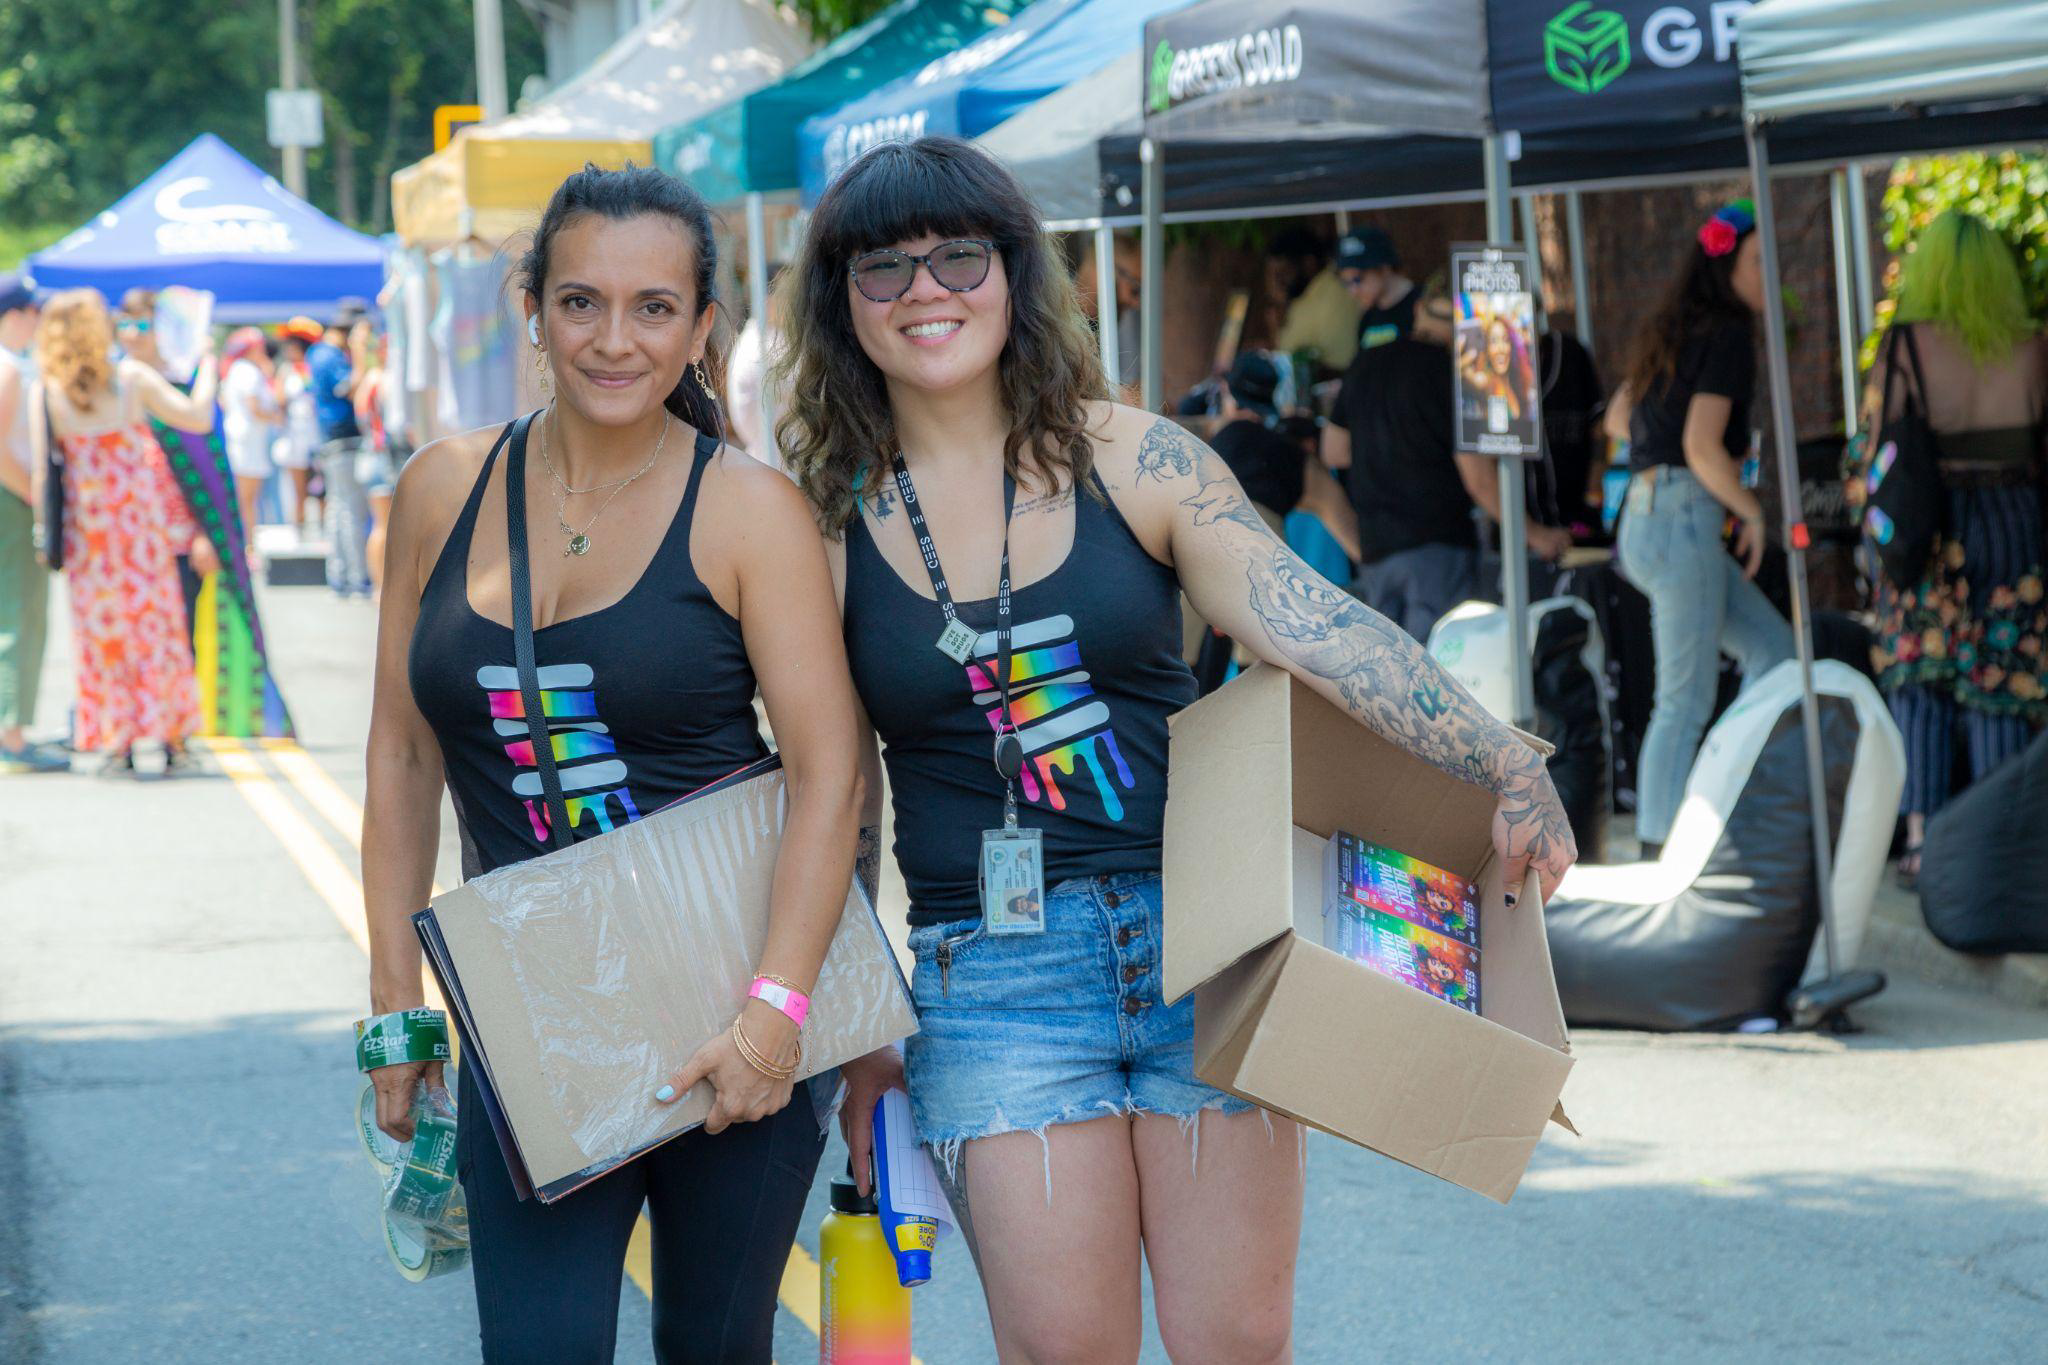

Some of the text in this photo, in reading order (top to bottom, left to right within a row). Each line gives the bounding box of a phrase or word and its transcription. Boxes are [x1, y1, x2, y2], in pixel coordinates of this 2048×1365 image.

[1237, 24, 1303, 87] GOLD
[897, 470, 916, 503] SEED
[920, 535, 939, 569] SEED
[999, 579, 1010, 615] SEED
[1376, 861, 1401, 904] PARTY
[1392, 866, 1416, 910] BLOCK
[1377, 927, 1401, 975] PARTY
[1393, 933, 1417, 979] BLOCK
[364, 1033, 412, 1052] EZStart
[434, 1130, 455, 1182] EZStart
